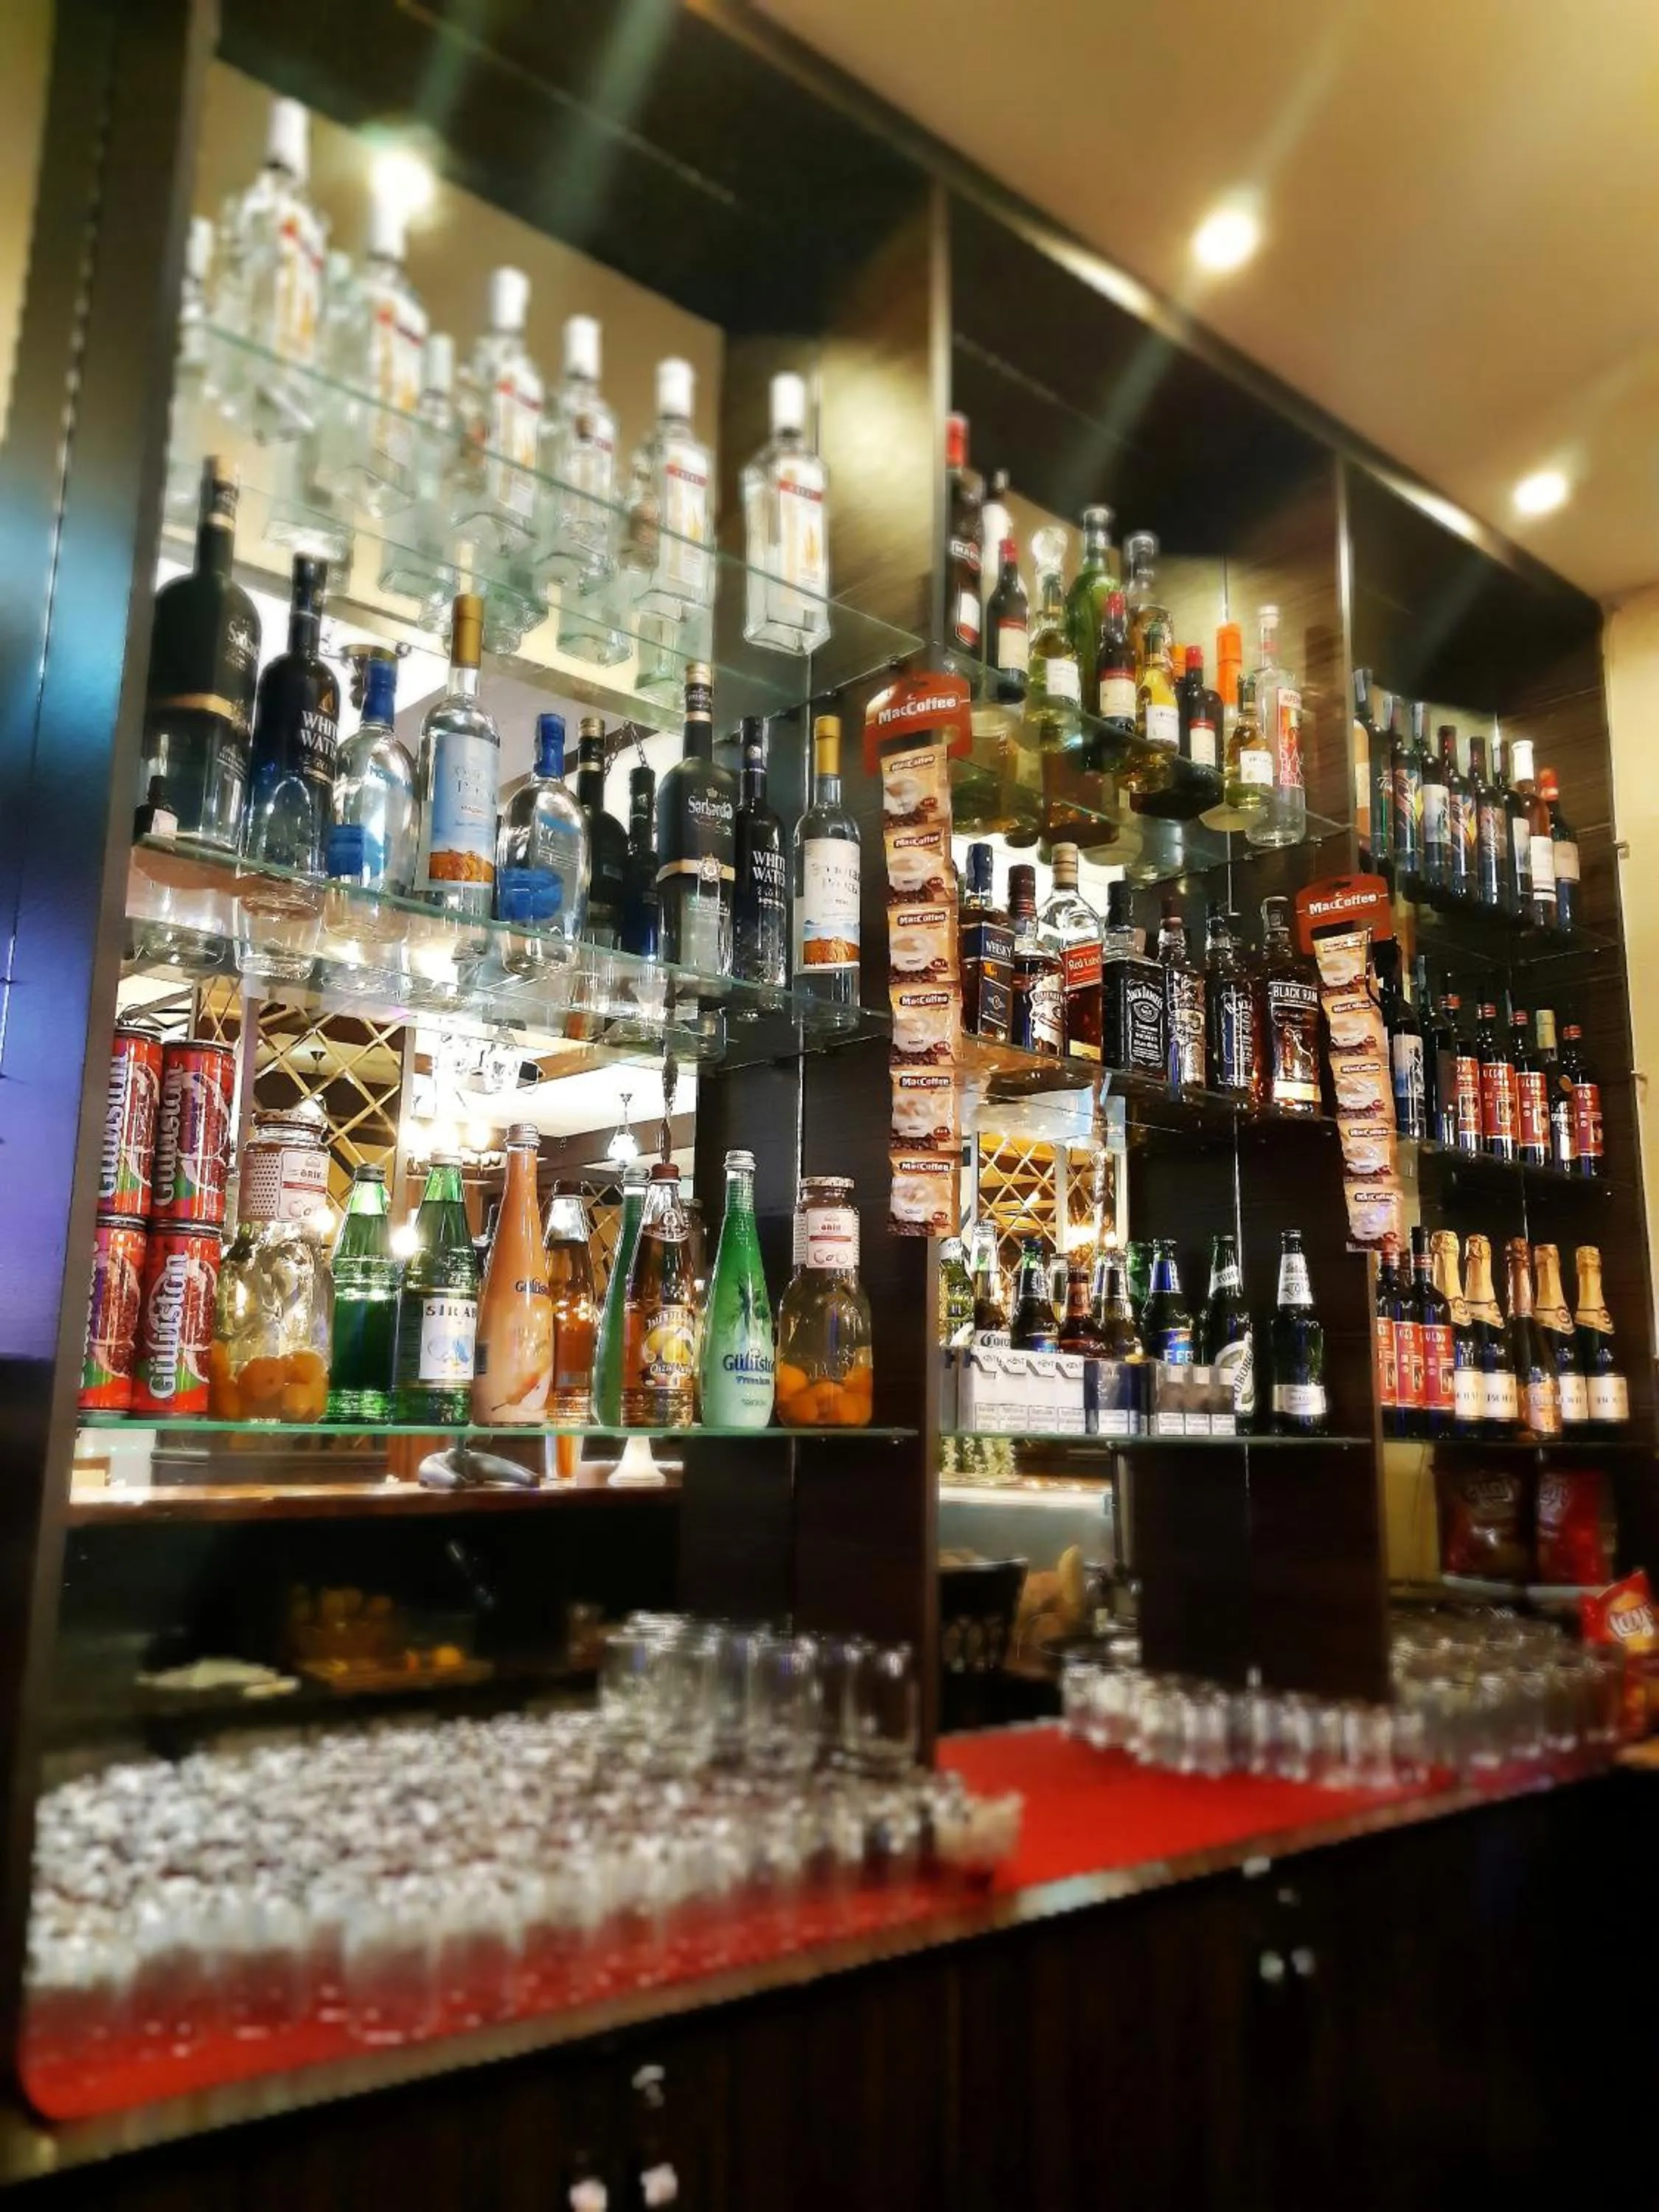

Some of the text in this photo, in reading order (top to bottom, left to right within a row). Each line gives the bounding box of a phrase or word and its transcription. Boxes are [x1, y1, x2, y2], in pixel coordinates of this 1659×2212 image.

[878, 696, 956, 725] MacCoffee
[301, 710, 338, 740] WHIT
[895, 835, 940, 847] MacCoffee
[1310, 894, 1377, 915] MacCoffee
[899, 914, 945, 926] MacCoffee
[1068, 959, 1083, 971] Red
[1273, 986, 1300, 998] BLACK
[902, 995, 947, 1006] MacCoffee
[902, 1077, 949, 1087] MacCoffee
[902, 1162, 950, 1172] MacCoffee
